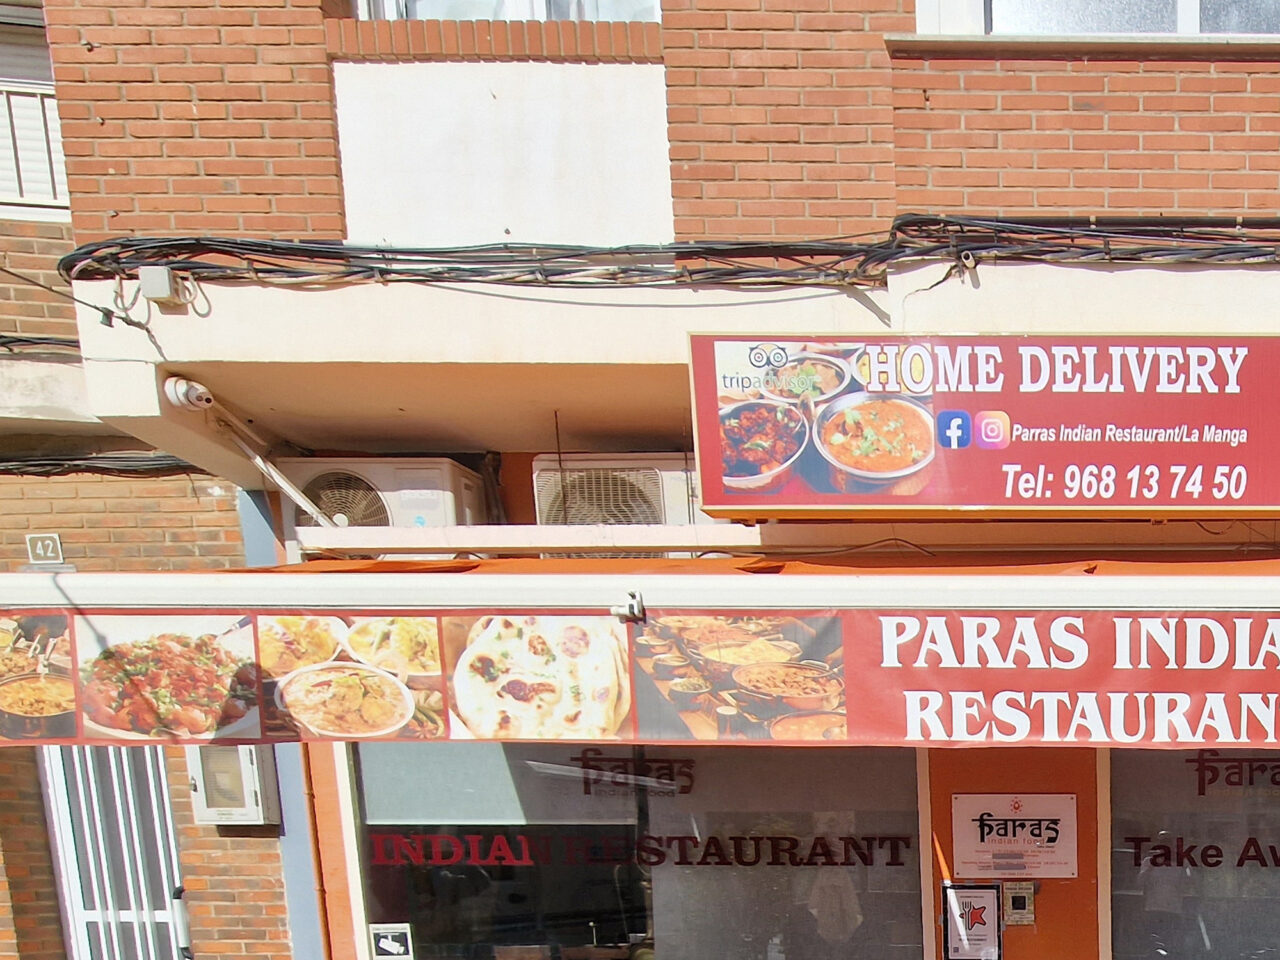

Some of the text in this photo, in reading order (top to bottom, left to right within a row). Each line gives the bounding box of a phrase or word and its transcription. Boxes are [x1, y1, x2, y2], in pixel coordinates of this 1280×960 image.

[866, 344, 1248, 393] HOME DELIVERY
[1012, 424, 1247, 447] Parras Indian Restaurant/La Manga
[1002, 464, 1248, 500] Tel: 968 13 74 50
[36, 540, 56, 556] 42
[879, 615, 1089, 669] PARAS
[369, 833, 911, 867] INDIAN RESTAURANT
[1124, 836, 1224, 869] Take
